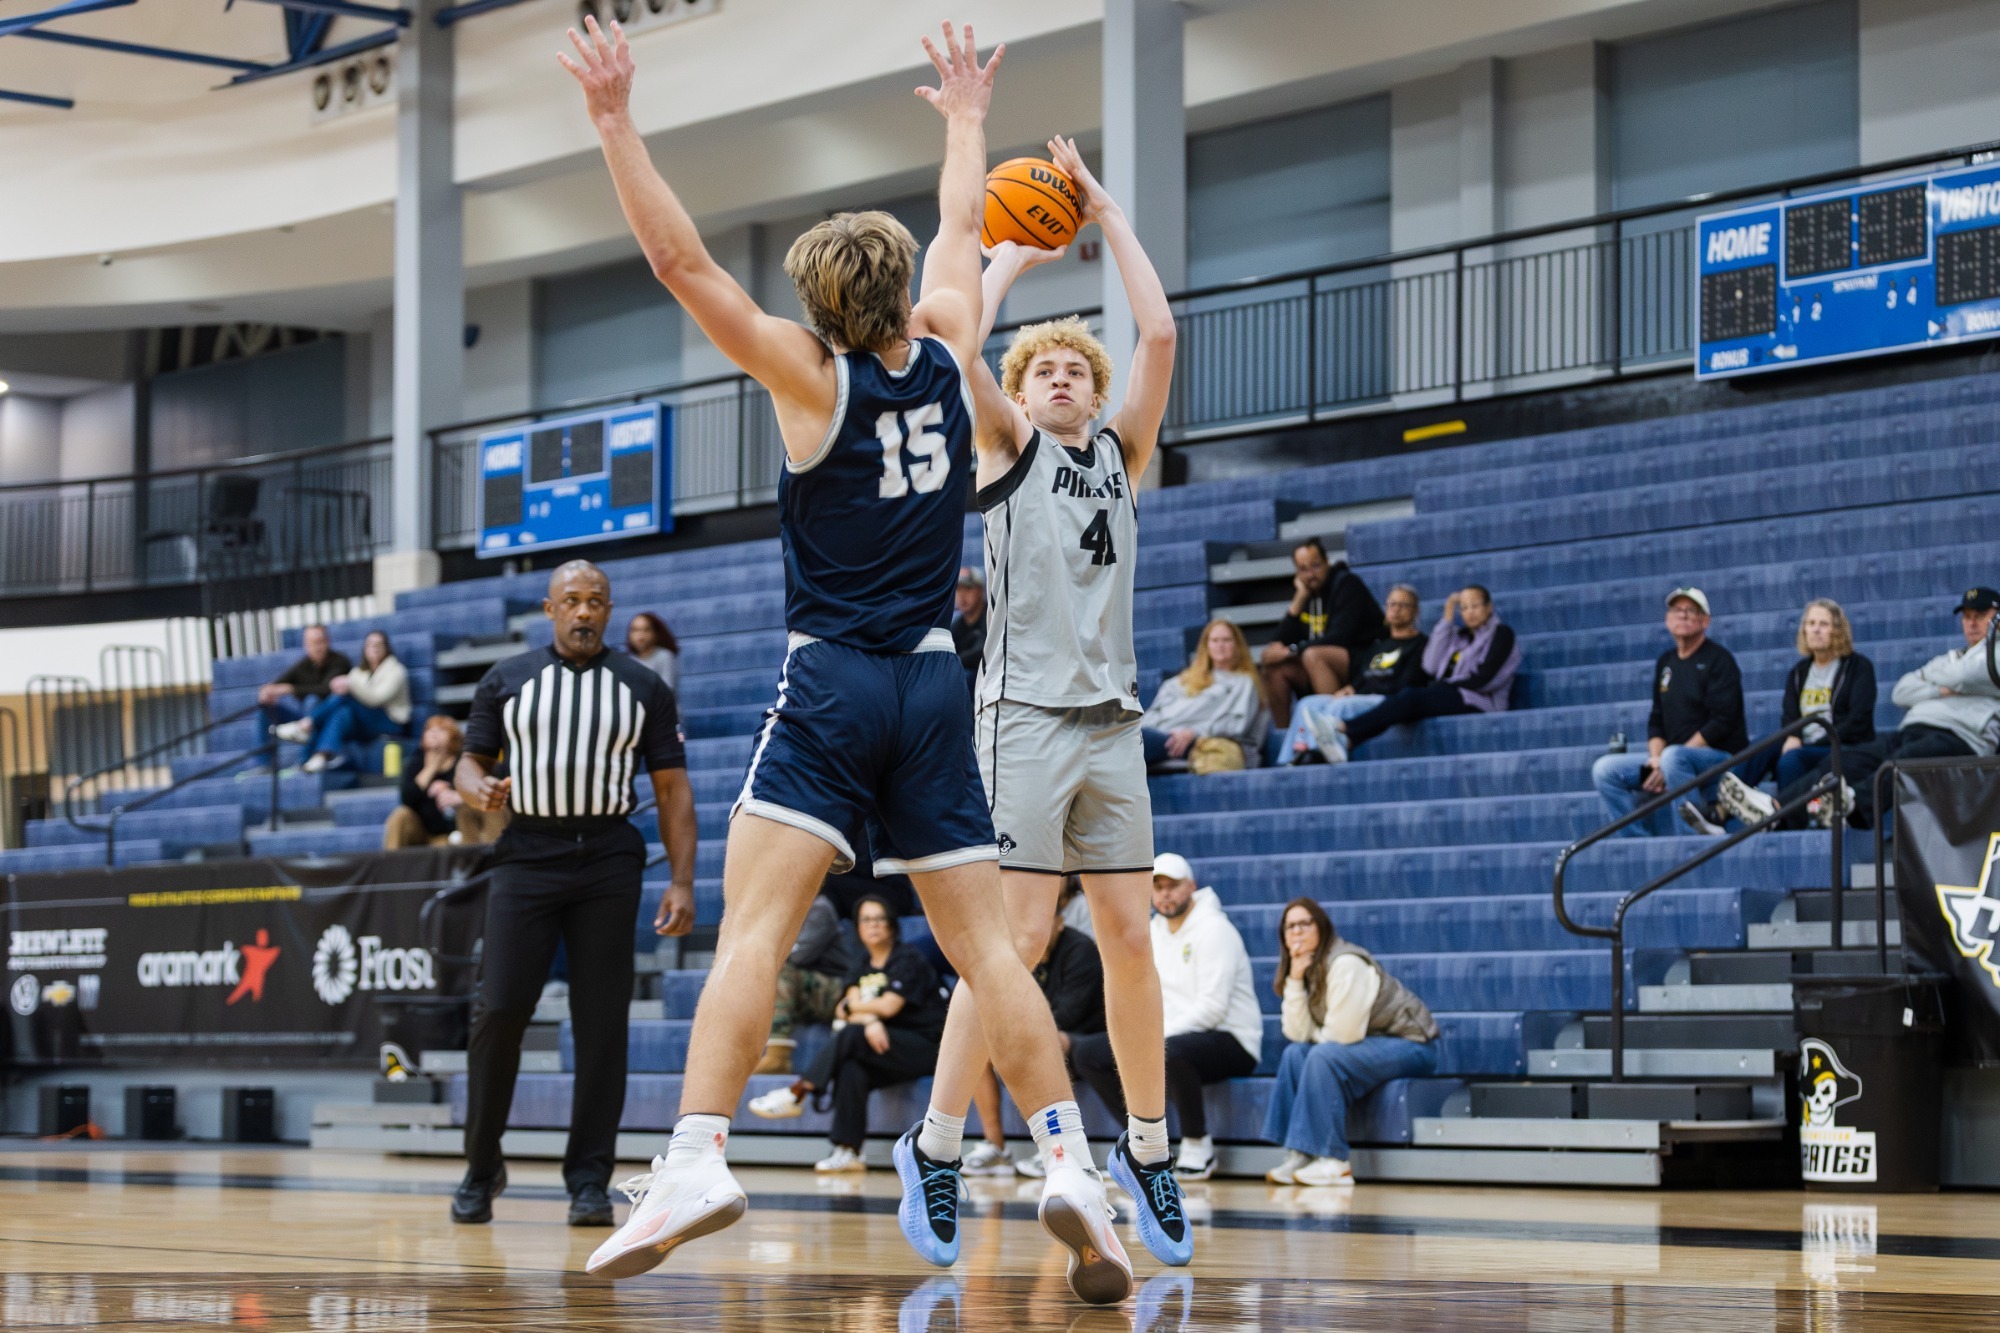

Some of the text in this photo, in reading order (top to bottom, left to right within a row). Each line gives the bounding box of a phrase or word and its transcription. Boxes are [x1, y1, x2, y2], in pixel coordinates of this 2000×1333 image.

[1030, 168, 1083, 220] Wilson
[1026, 205, 1065, 236] EVO
[1707, 222, 1772, 264] HOME
[1792, 301, 1822, 324] 1 2
[1886, 286, 1917, 309] 3 4
[1711, 348, 1749, 371] BONUS
[875, 401, 950, 499] 15
[1079, 508, 1117, 566] 4
[137, 940, 241, 988] aramark
